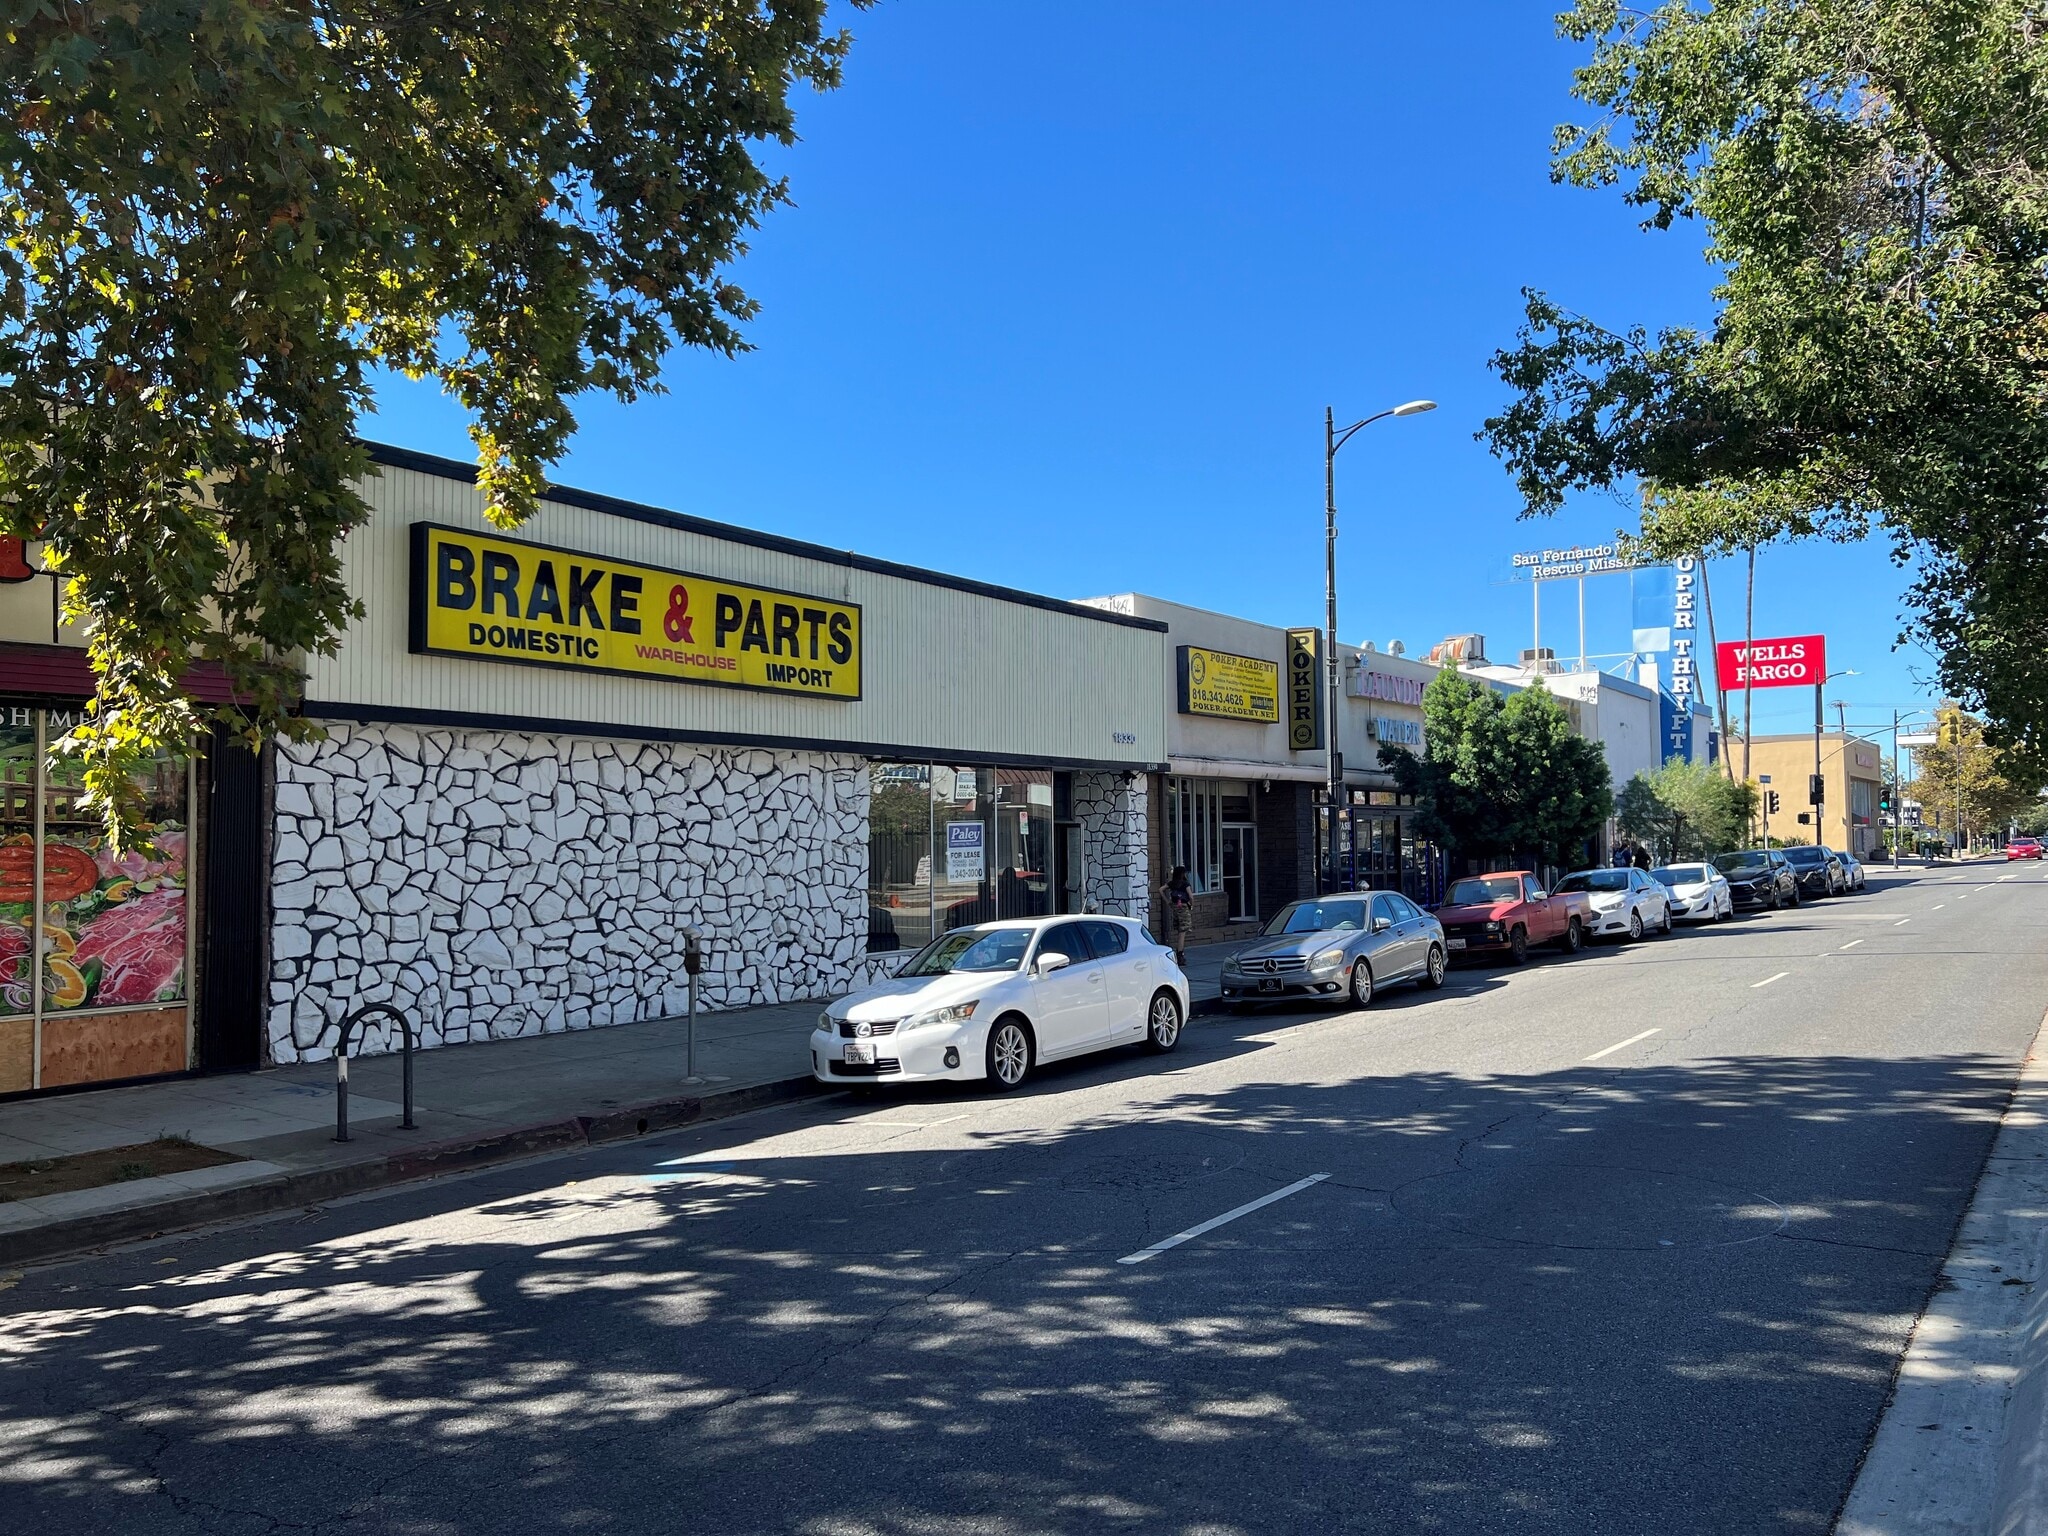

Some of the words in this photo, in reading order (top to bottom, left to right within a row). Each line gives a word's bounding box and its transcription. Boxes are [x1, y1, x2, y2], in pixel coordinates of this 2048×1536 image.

[1513, 553, 1540, 567] San
[1543, 545, 1612, 563] Fernando
[1532, 562, 1584, 578] Rescue
[437, 541, 642, 636] BRAKE
[664, 584, 695, 644] &
[716, 593, 853, 665] PARTS
[469, 623, 599, 659] DOMESTIC
[635, 645, 737, 670] WAREHOUSE
[1210, 653, 1238, 666] POKER
[1239, 658, 1275, 673] ACADEMY
[1733, 644, 1806, 663] WELLS
[766, 663, 833, 688] IMPORT
[1293, 635, 1312, 721] POKER
[1736, 663, 1807, 682] FARGO
[1192, 688, 1244, 706] 818.343.4626
[1670, 639, 1693, 749] THRIFT
[1377, 717, 1420, 745] WATER
[951, 827, 980, 841] Paley
[964, 850, 980, 858] LEASE
